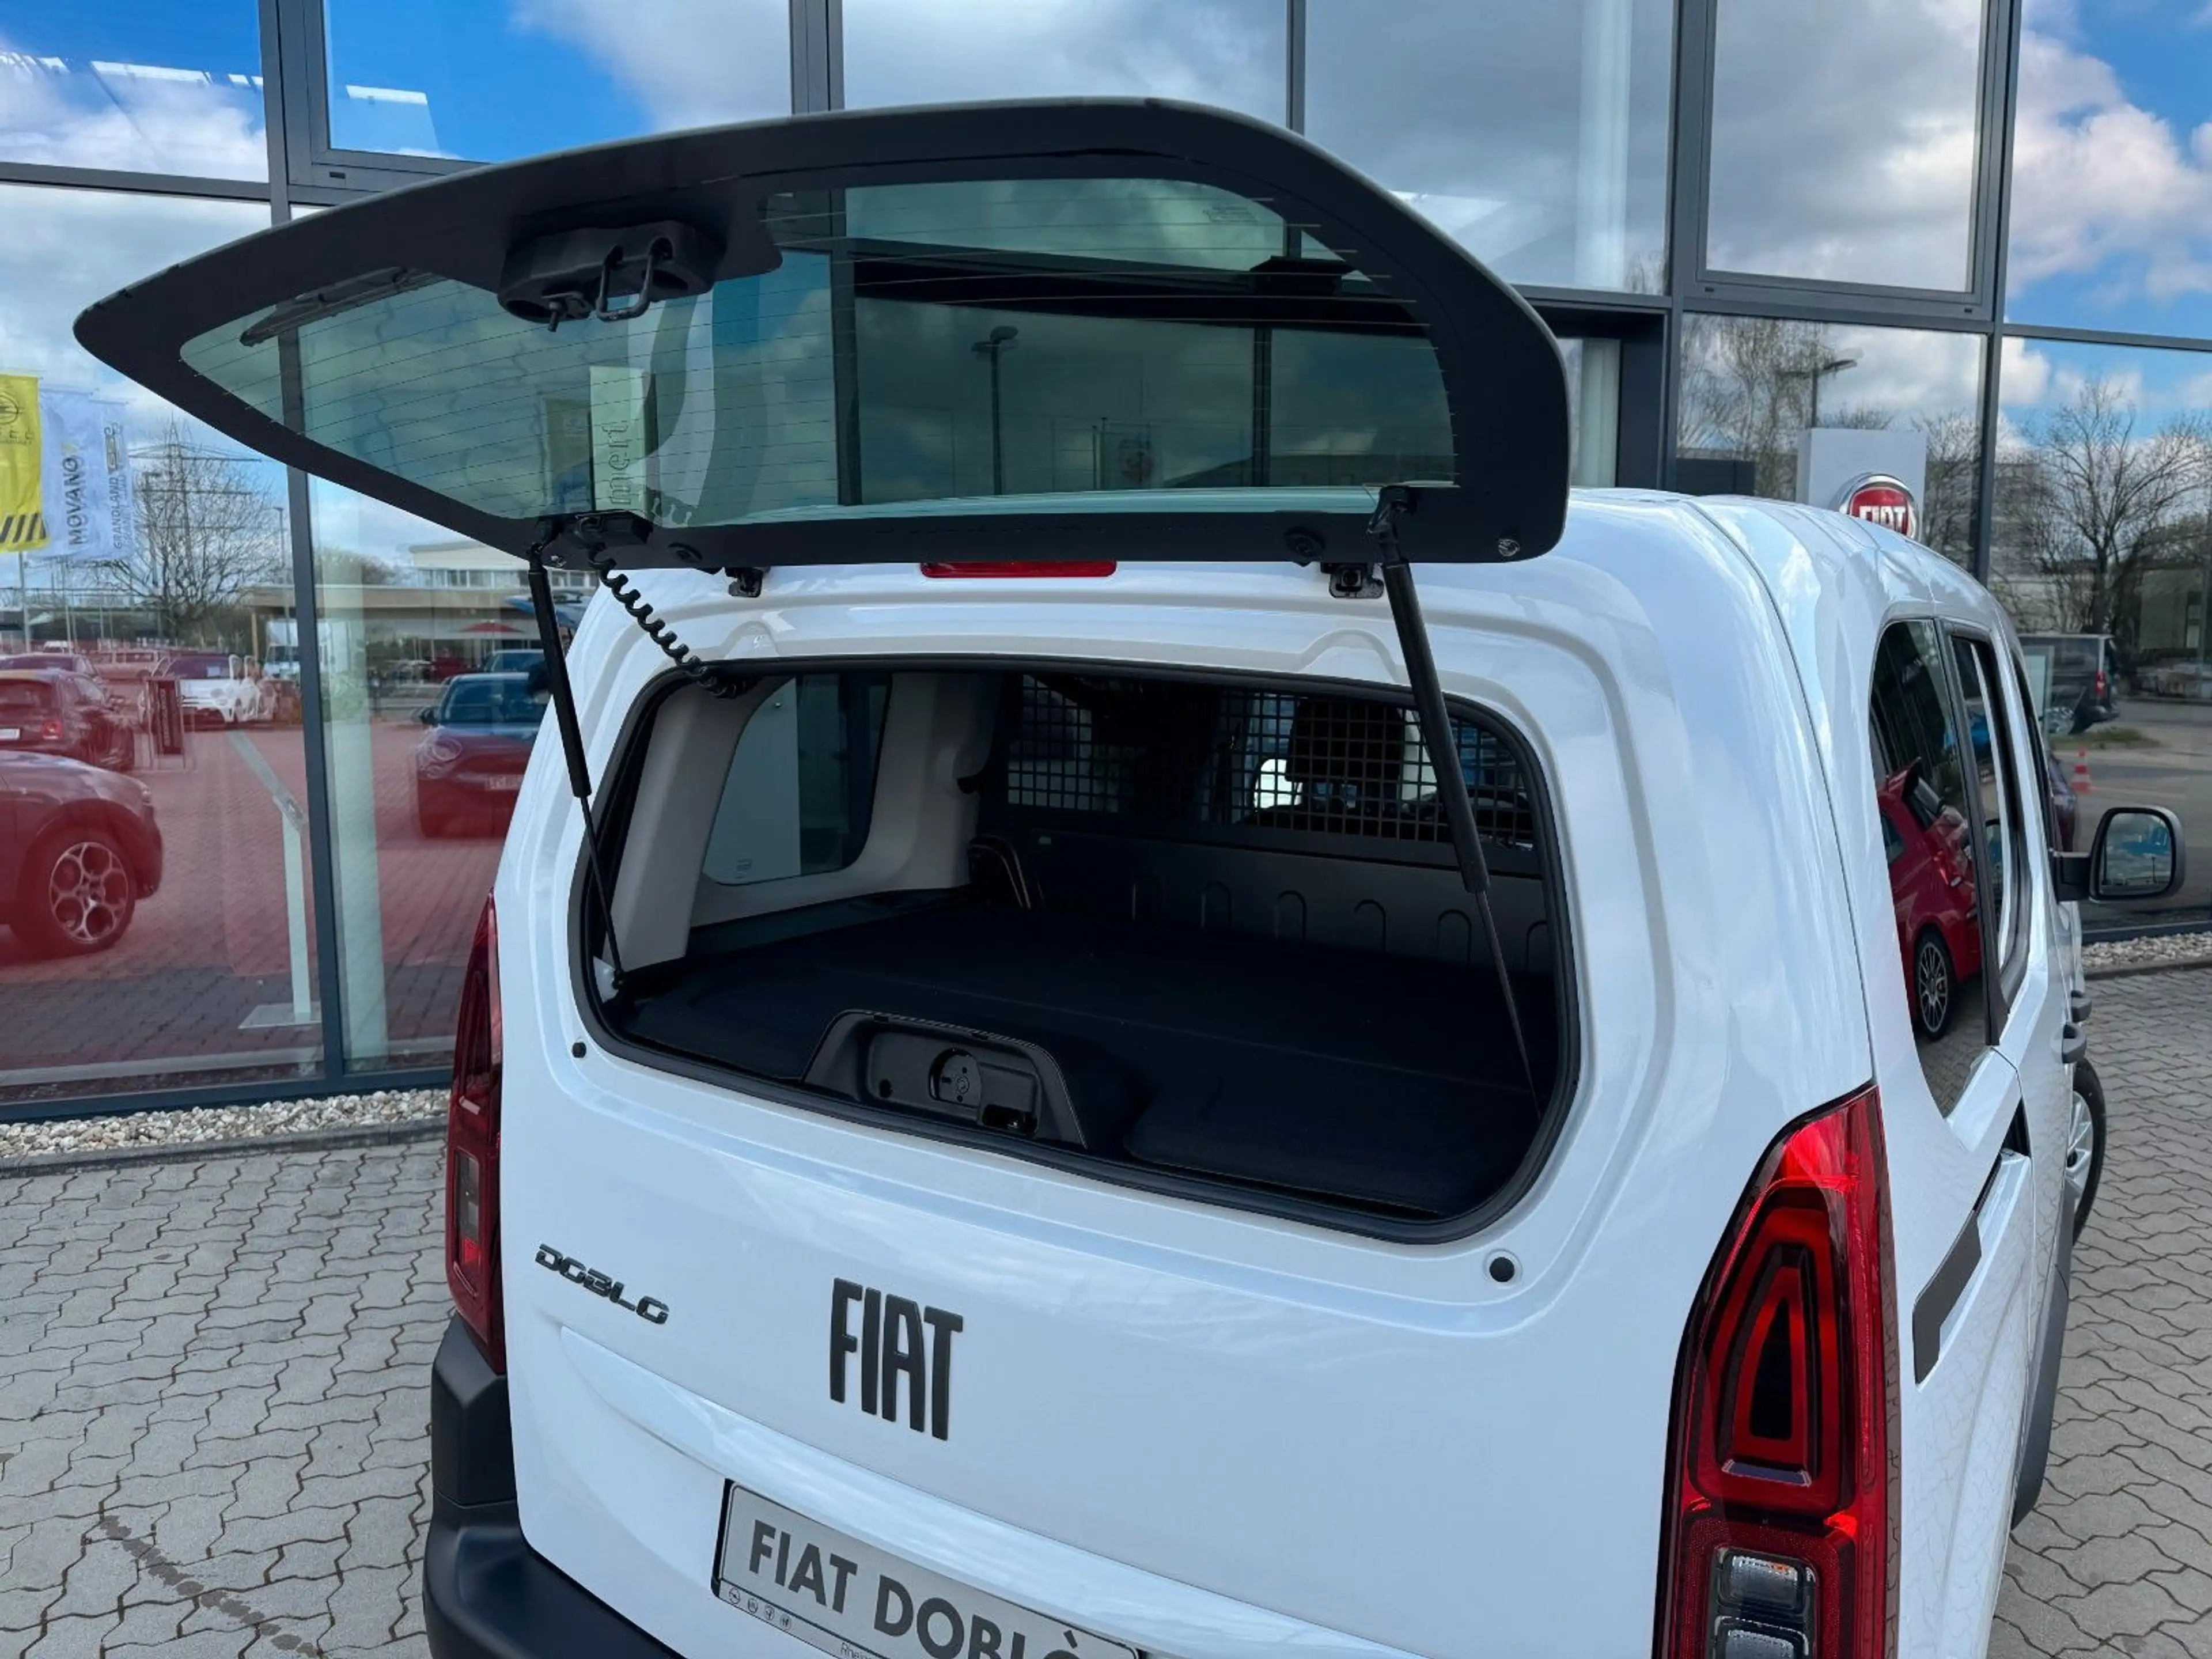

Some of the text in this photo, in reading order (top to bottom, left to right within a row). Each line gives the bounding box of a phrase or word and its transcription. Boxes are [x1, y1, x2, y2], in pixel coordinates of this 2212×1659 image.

[62, 456, 83, 545] MOVANO
[535, 1243, 670, 1325] DOBLO
[830, 1277, 964, 1441] FIAT
[749, 1519, 858, 1614] FIAT
